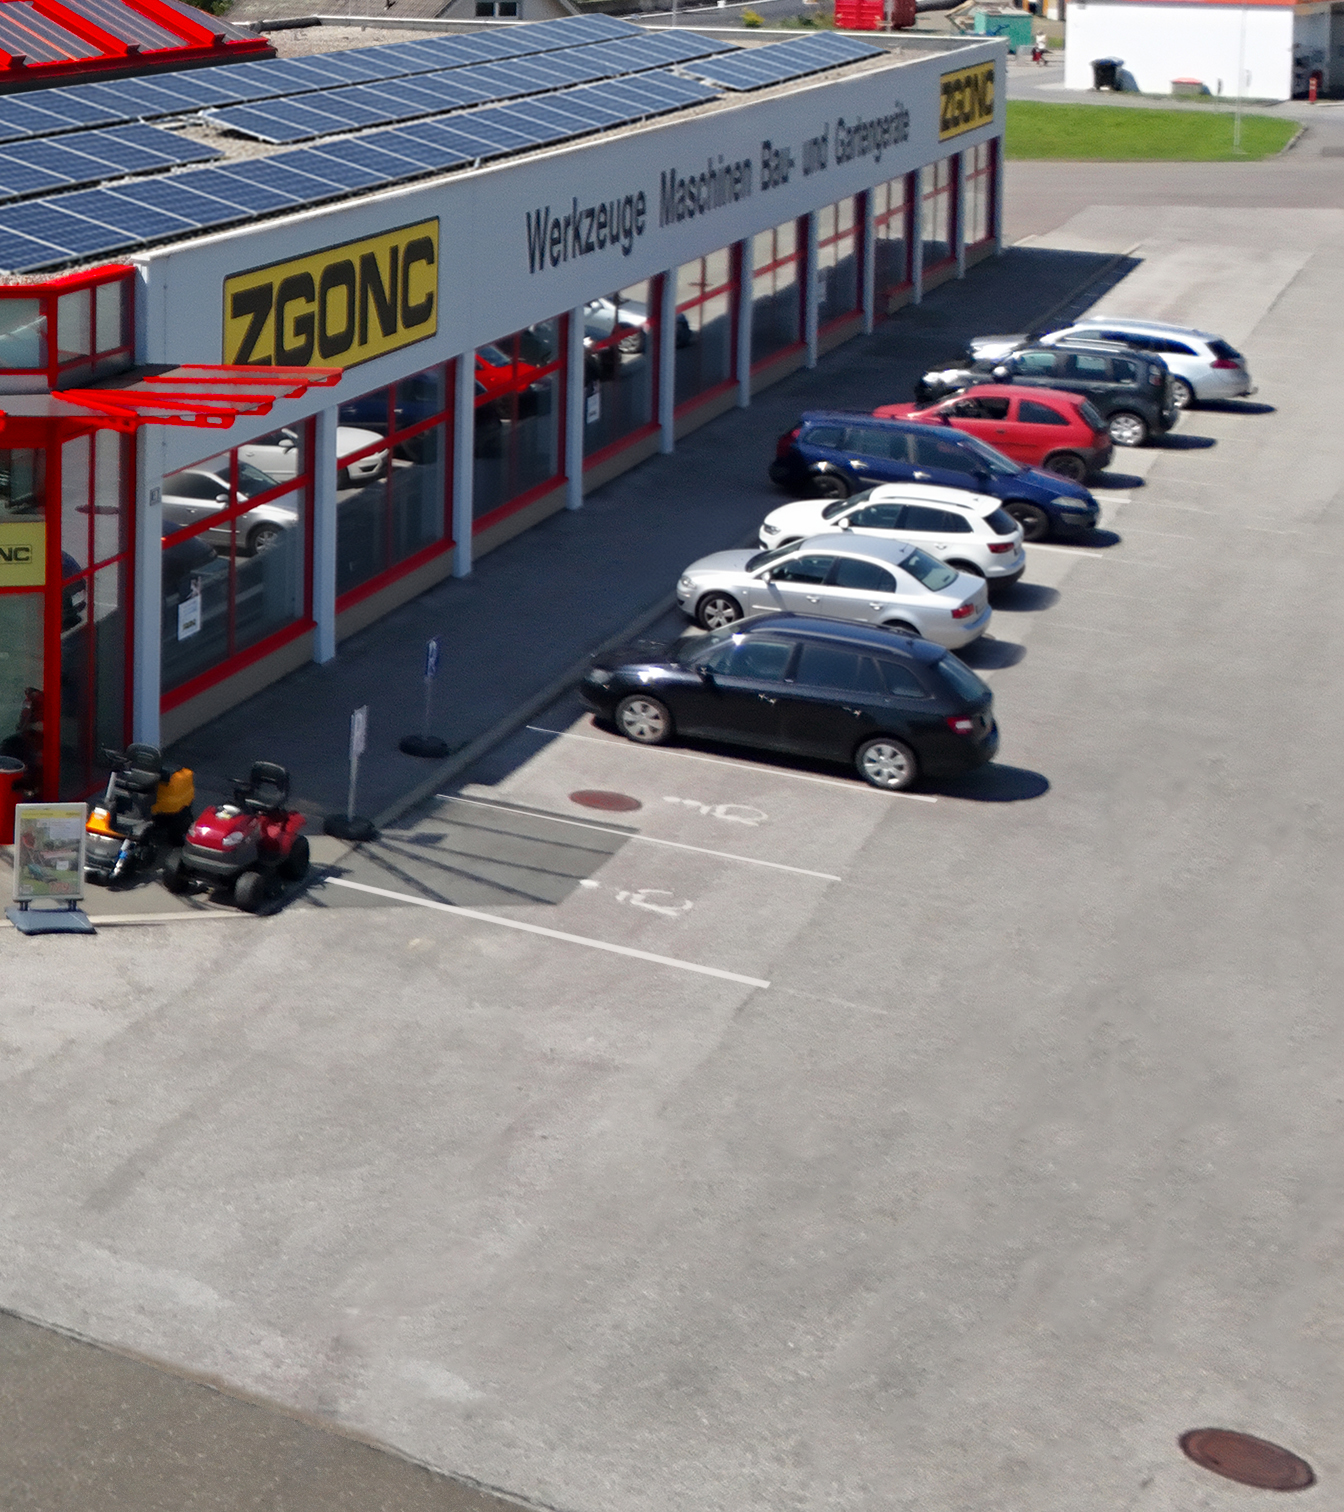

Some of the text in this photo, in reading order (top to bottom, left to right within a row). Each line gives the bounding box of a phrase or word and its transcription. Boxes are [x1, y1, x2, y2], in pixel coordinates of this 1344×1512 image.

[942, 70, 994, 133] ZGONC
[525, 100, 910, 274] Werkzeuge Maschinen Bau- und Gartengeräte
[231, 235, 435, 368] ZGONC
